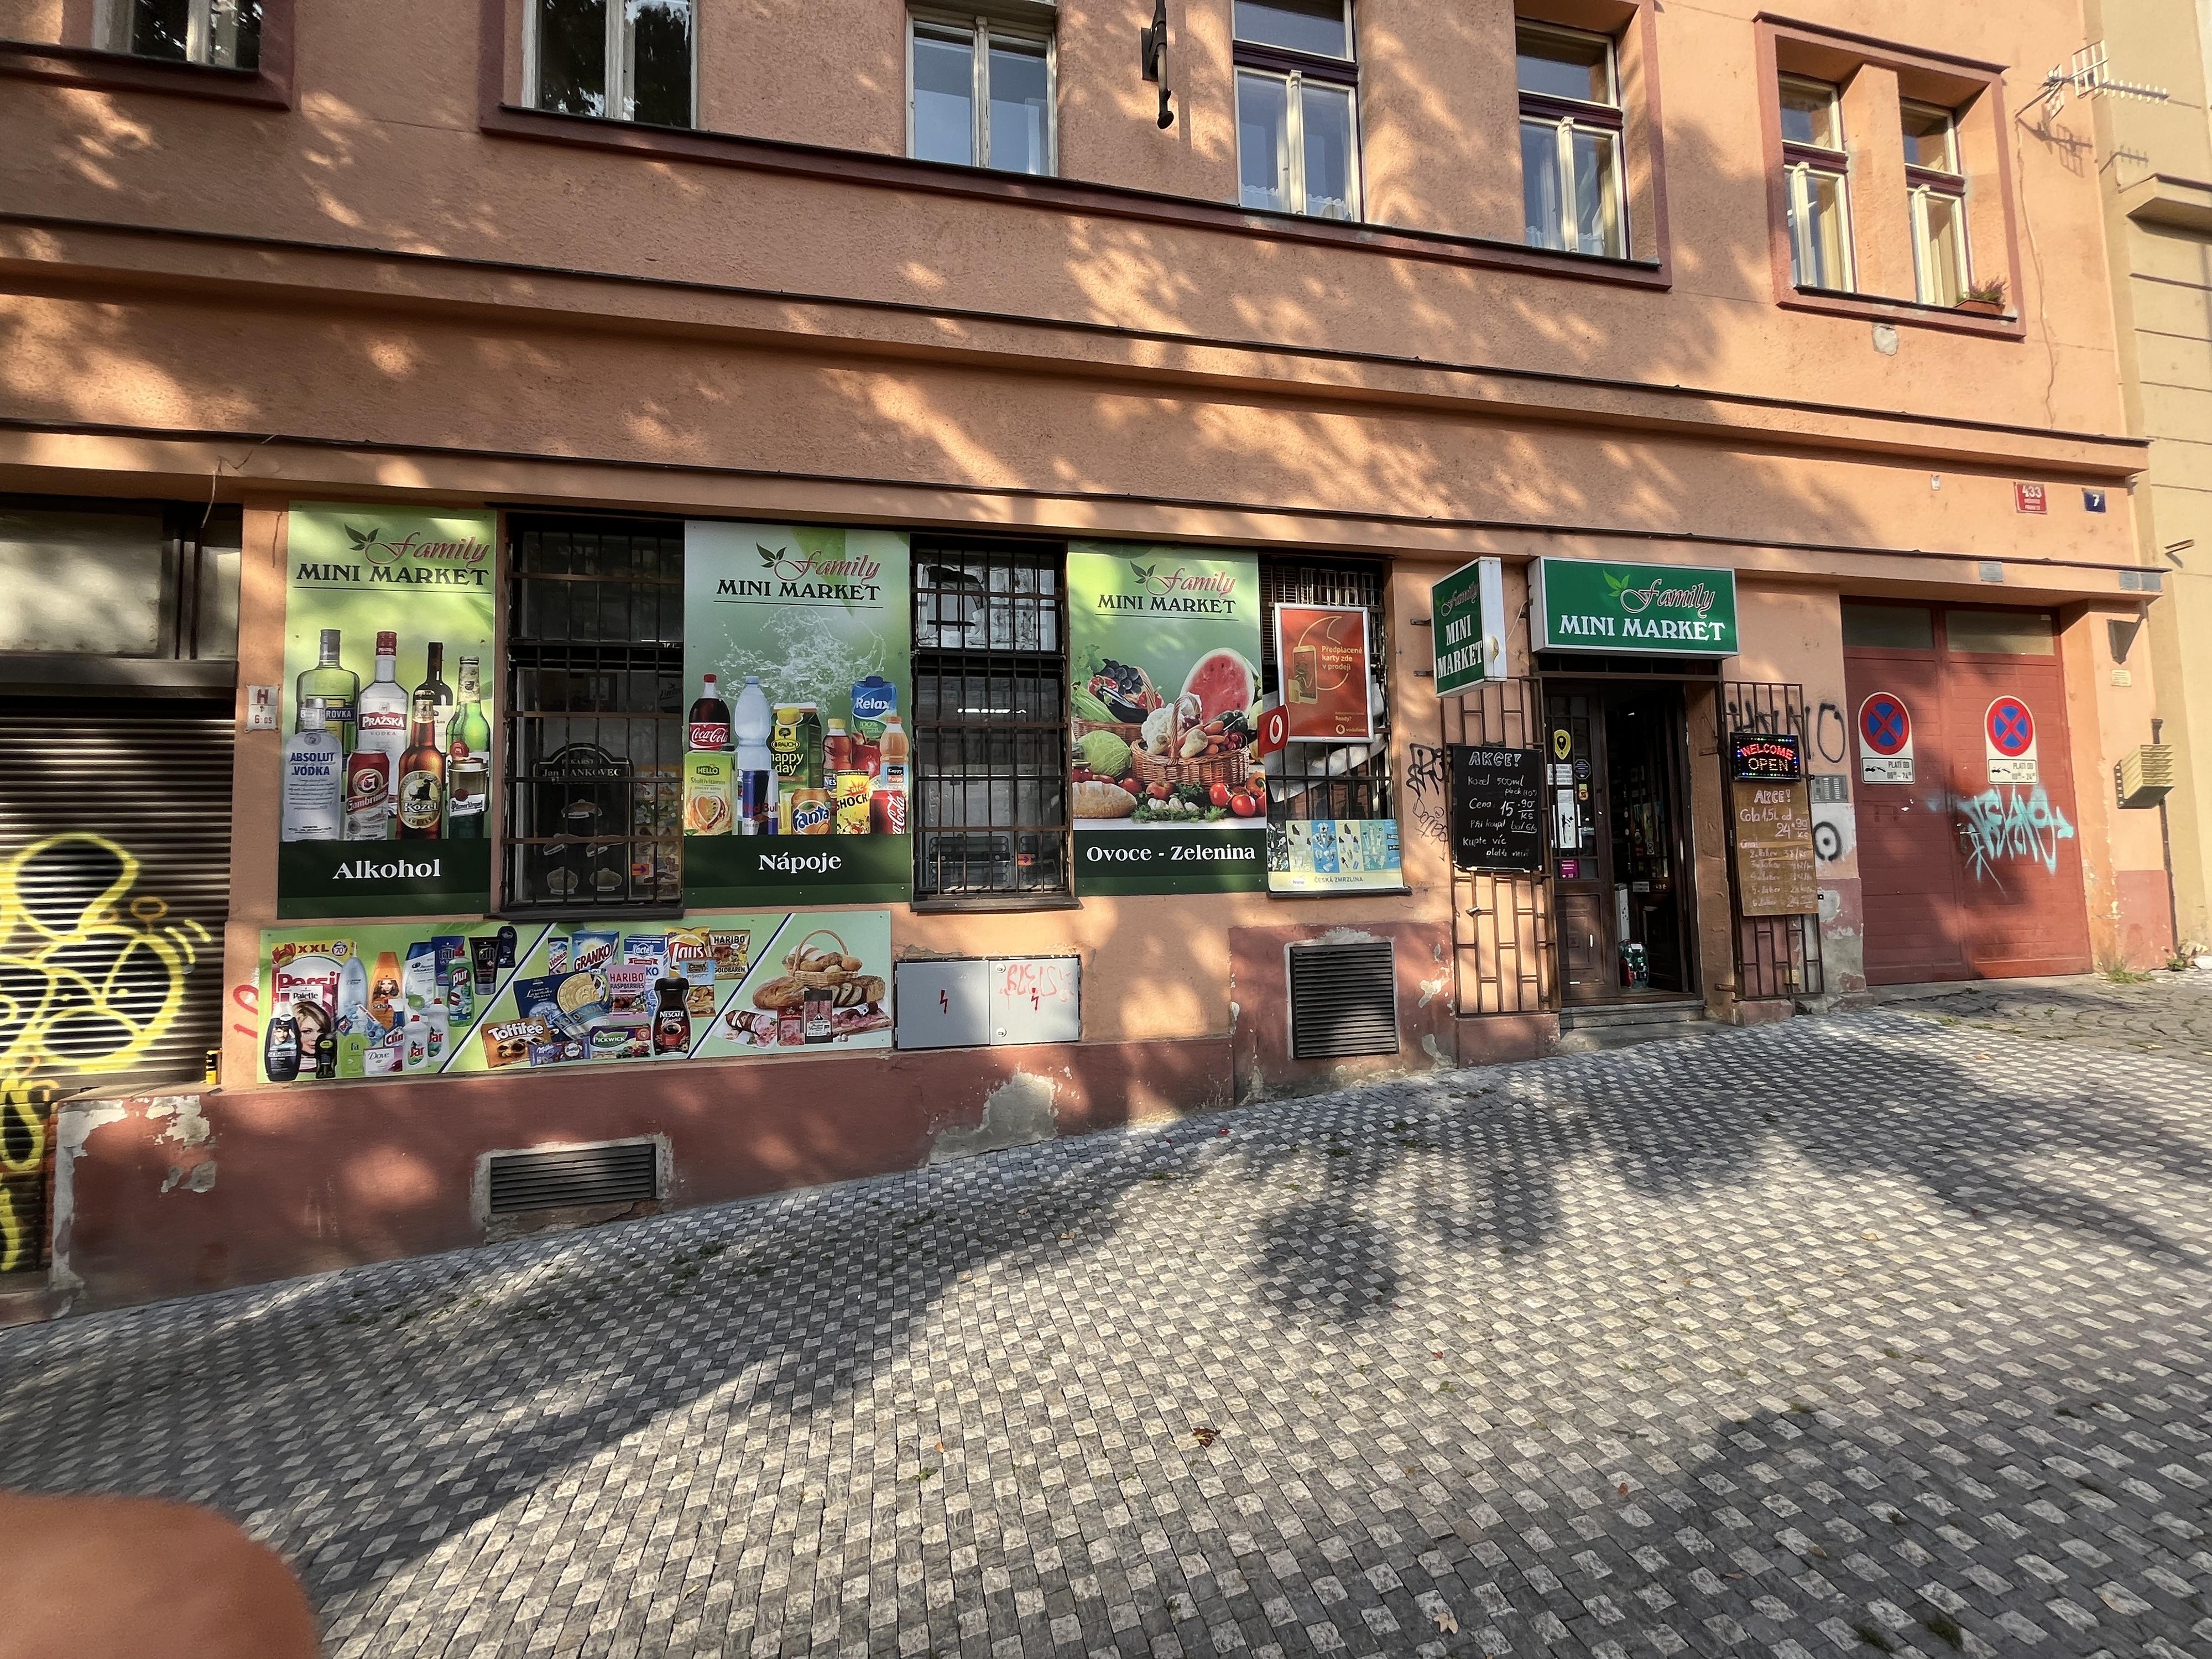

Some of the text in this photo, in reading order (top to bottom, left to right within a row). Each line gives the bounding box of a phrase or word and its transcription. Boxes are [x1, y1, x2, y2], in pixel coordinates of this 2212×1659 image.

[2022, 485, 2042, 498] 433
[2093, 494, 2100, 507] 7
[365, 531, 490, 570] Family
[296, 563, 489, 585] MINI MARKET
[774, 550, 881, 586] Family
[716, 579, 881, 601] MINI MARKET
[1146, 567, 1237, 600] Family
[1098, 594, 1237, 614] MINI MARKET
[1441, 581, 1479, 617] Family
[1620, 578, 1716, 619] Family
[1445, 613, 1472, 646] MINI
[1559, 614, 1725, 641] MINI MARKET
[1321, 645, 1363, 654] Předplacené
[1322, 654, 1340, 662] karty
[1437, 640, 1483, 679] MARKET
[257, 689, 269, 704] H
[857, 697, 890, 710] Relax
[300, 709, 351, 718] BROVKA
[362, 716, 404, 728] PRAŽSKÁ
[691, 727, 728, 743] Coca-Cola
[290, 752, 335, 762] ABSOLUT
[1468, 751, 1522, 767] AKCE!
[1741, 743, 1795, 760] WELCOME
[293, 766, 330, 775] VODKA
[775, 762, 796, 776] day
[1748, 758, 1788, 771] OPEN
[404, 802, 439, 813] Kozel
[1740, 807, 1761, 822] Cola
[792, 806, 830, 832] Fanta
[1087, 846, 1152, 862] Ovoce
[1170, 844, 1256, 861] Zelenina
[332, 859, 441, 879] Alkohol
[759, 852, 842, 874] Nápoje
[714, 935, 745, 944] HARIBO
[298, 943, 330, 953] XXL
[575, 943, 611, 971] GRANKO
[452, 970, 468, 987] pur
[610, 973, 644, 982] HARIBO
[487, 1022, 544, 1041] Toffifee
[368, 1051, 389, 1060] Dove
[410, 1046, 425, 1057] Jar
